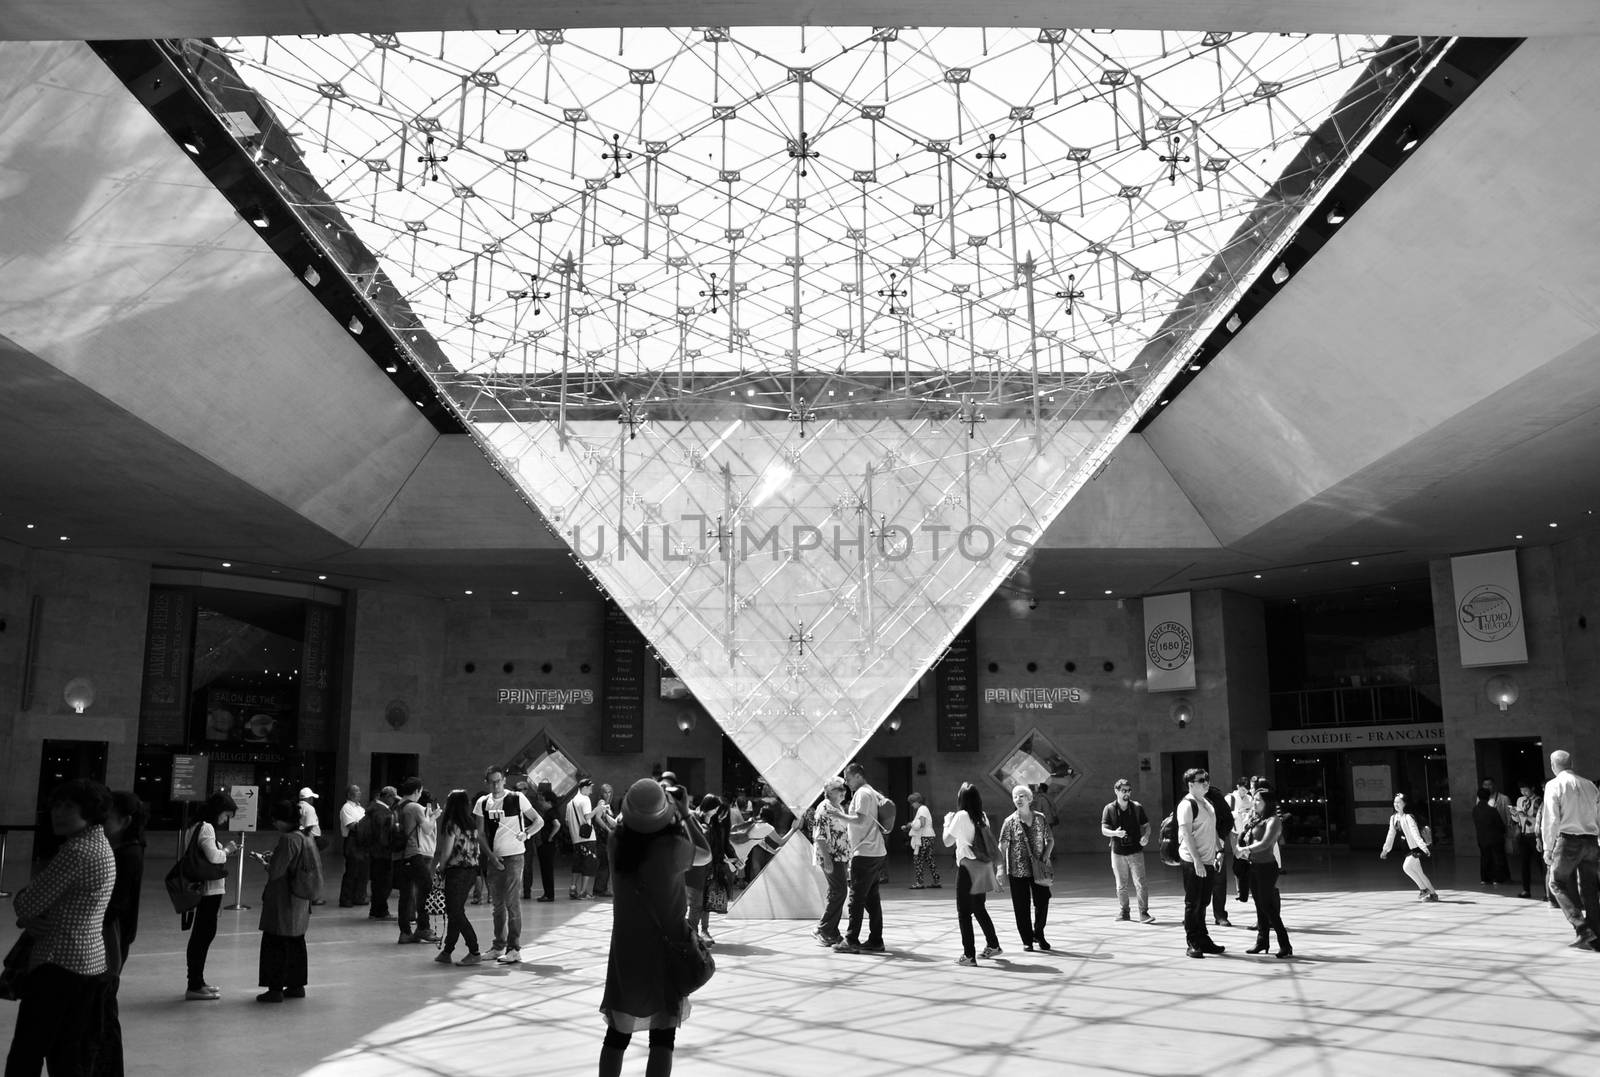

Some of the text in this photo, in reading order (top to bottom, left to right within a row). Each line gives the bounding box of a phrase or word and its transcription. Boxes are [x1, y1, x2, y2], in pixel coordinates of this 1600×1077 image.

[1159, 641, 1179, 652] 1680
[497, 688, 594, 705] PRINTEMPS
[984, 687, 1081, 704] PRINTEMPS
[1291, 731, 1353, 745] COMÉDIE
